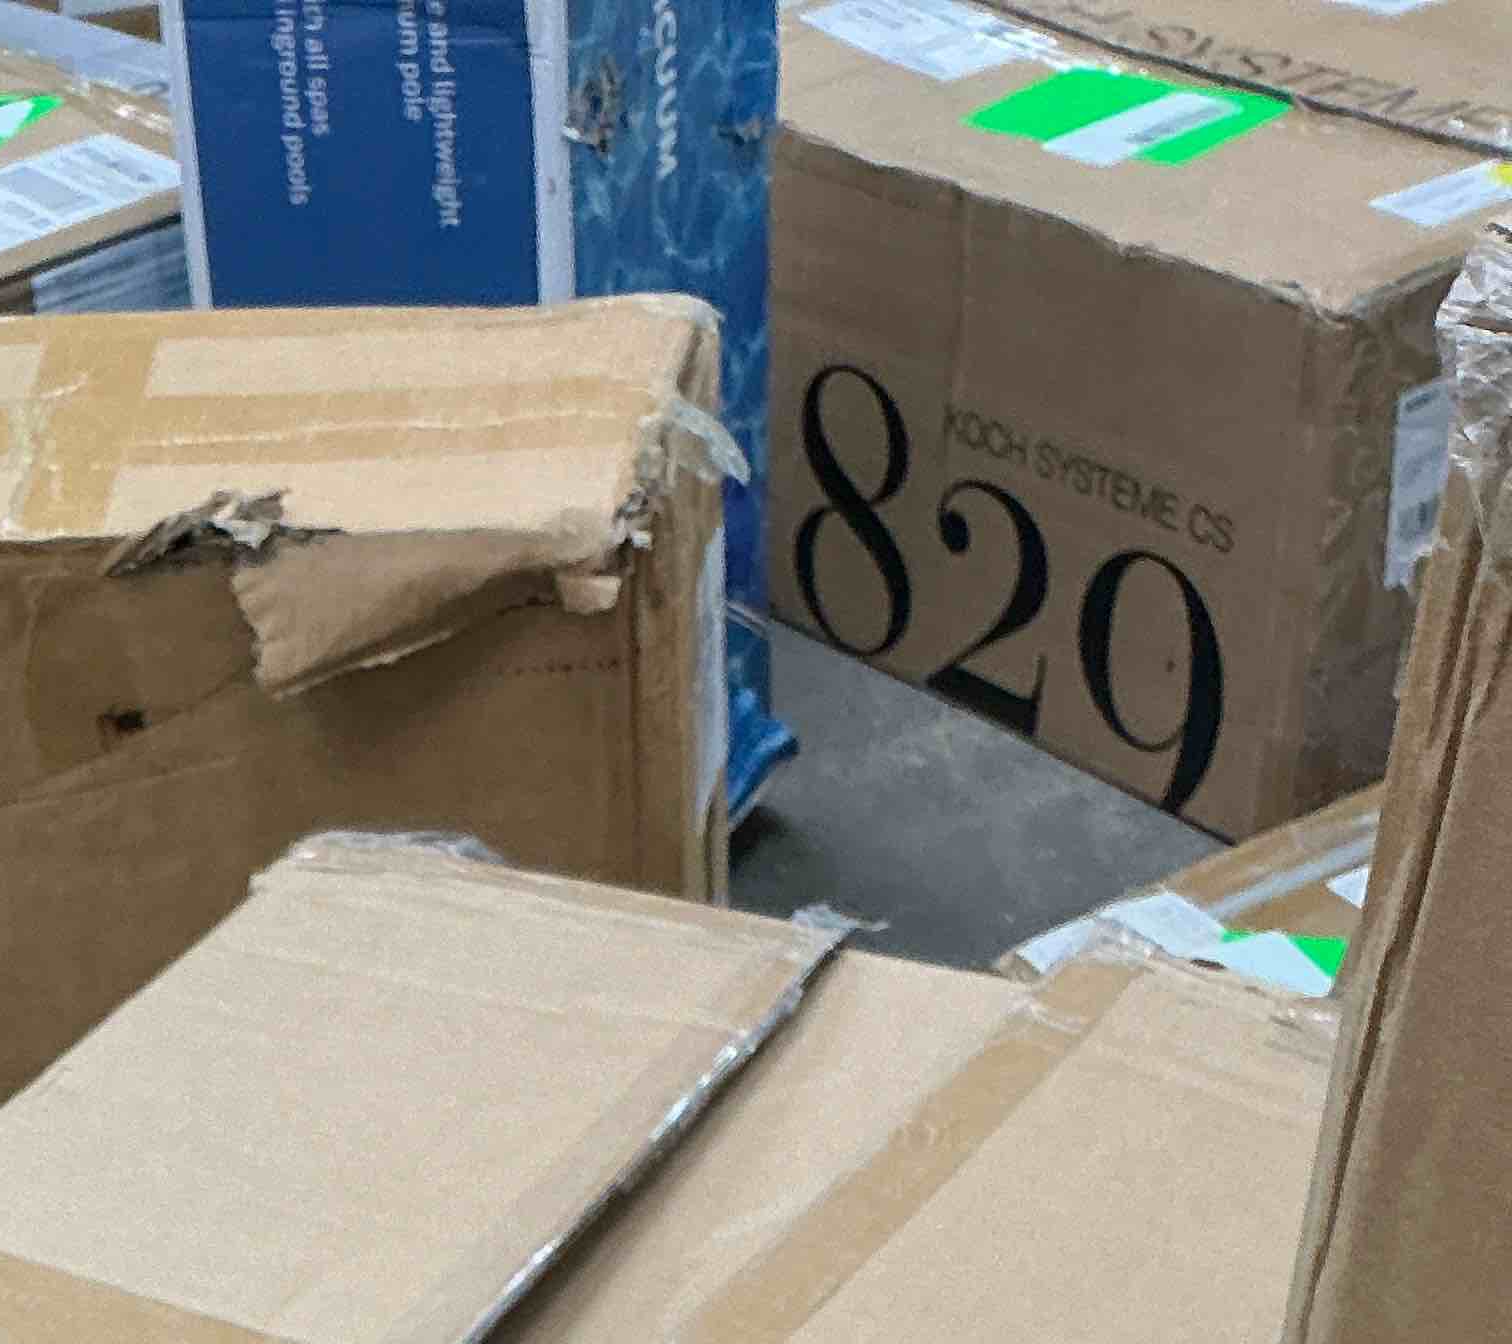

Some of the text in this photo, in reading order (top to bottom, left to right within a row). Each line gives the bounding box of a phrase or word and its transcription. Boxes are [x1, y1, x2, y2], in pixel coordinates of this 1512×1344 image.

[304, 39, 329, 72] all
[399, 62, 424, 122] pole
[427, 21, 455, 74] and
[271, 8, 312, 206] inground pools
[304, 76, 330, 137] spas
[426, 79, 462, 228] lightweight
[942, 402, 1028, 465] KOCH
[1035, 442, 1180, 532] SYSTEME
[794, 365, 1225, 813] 829
